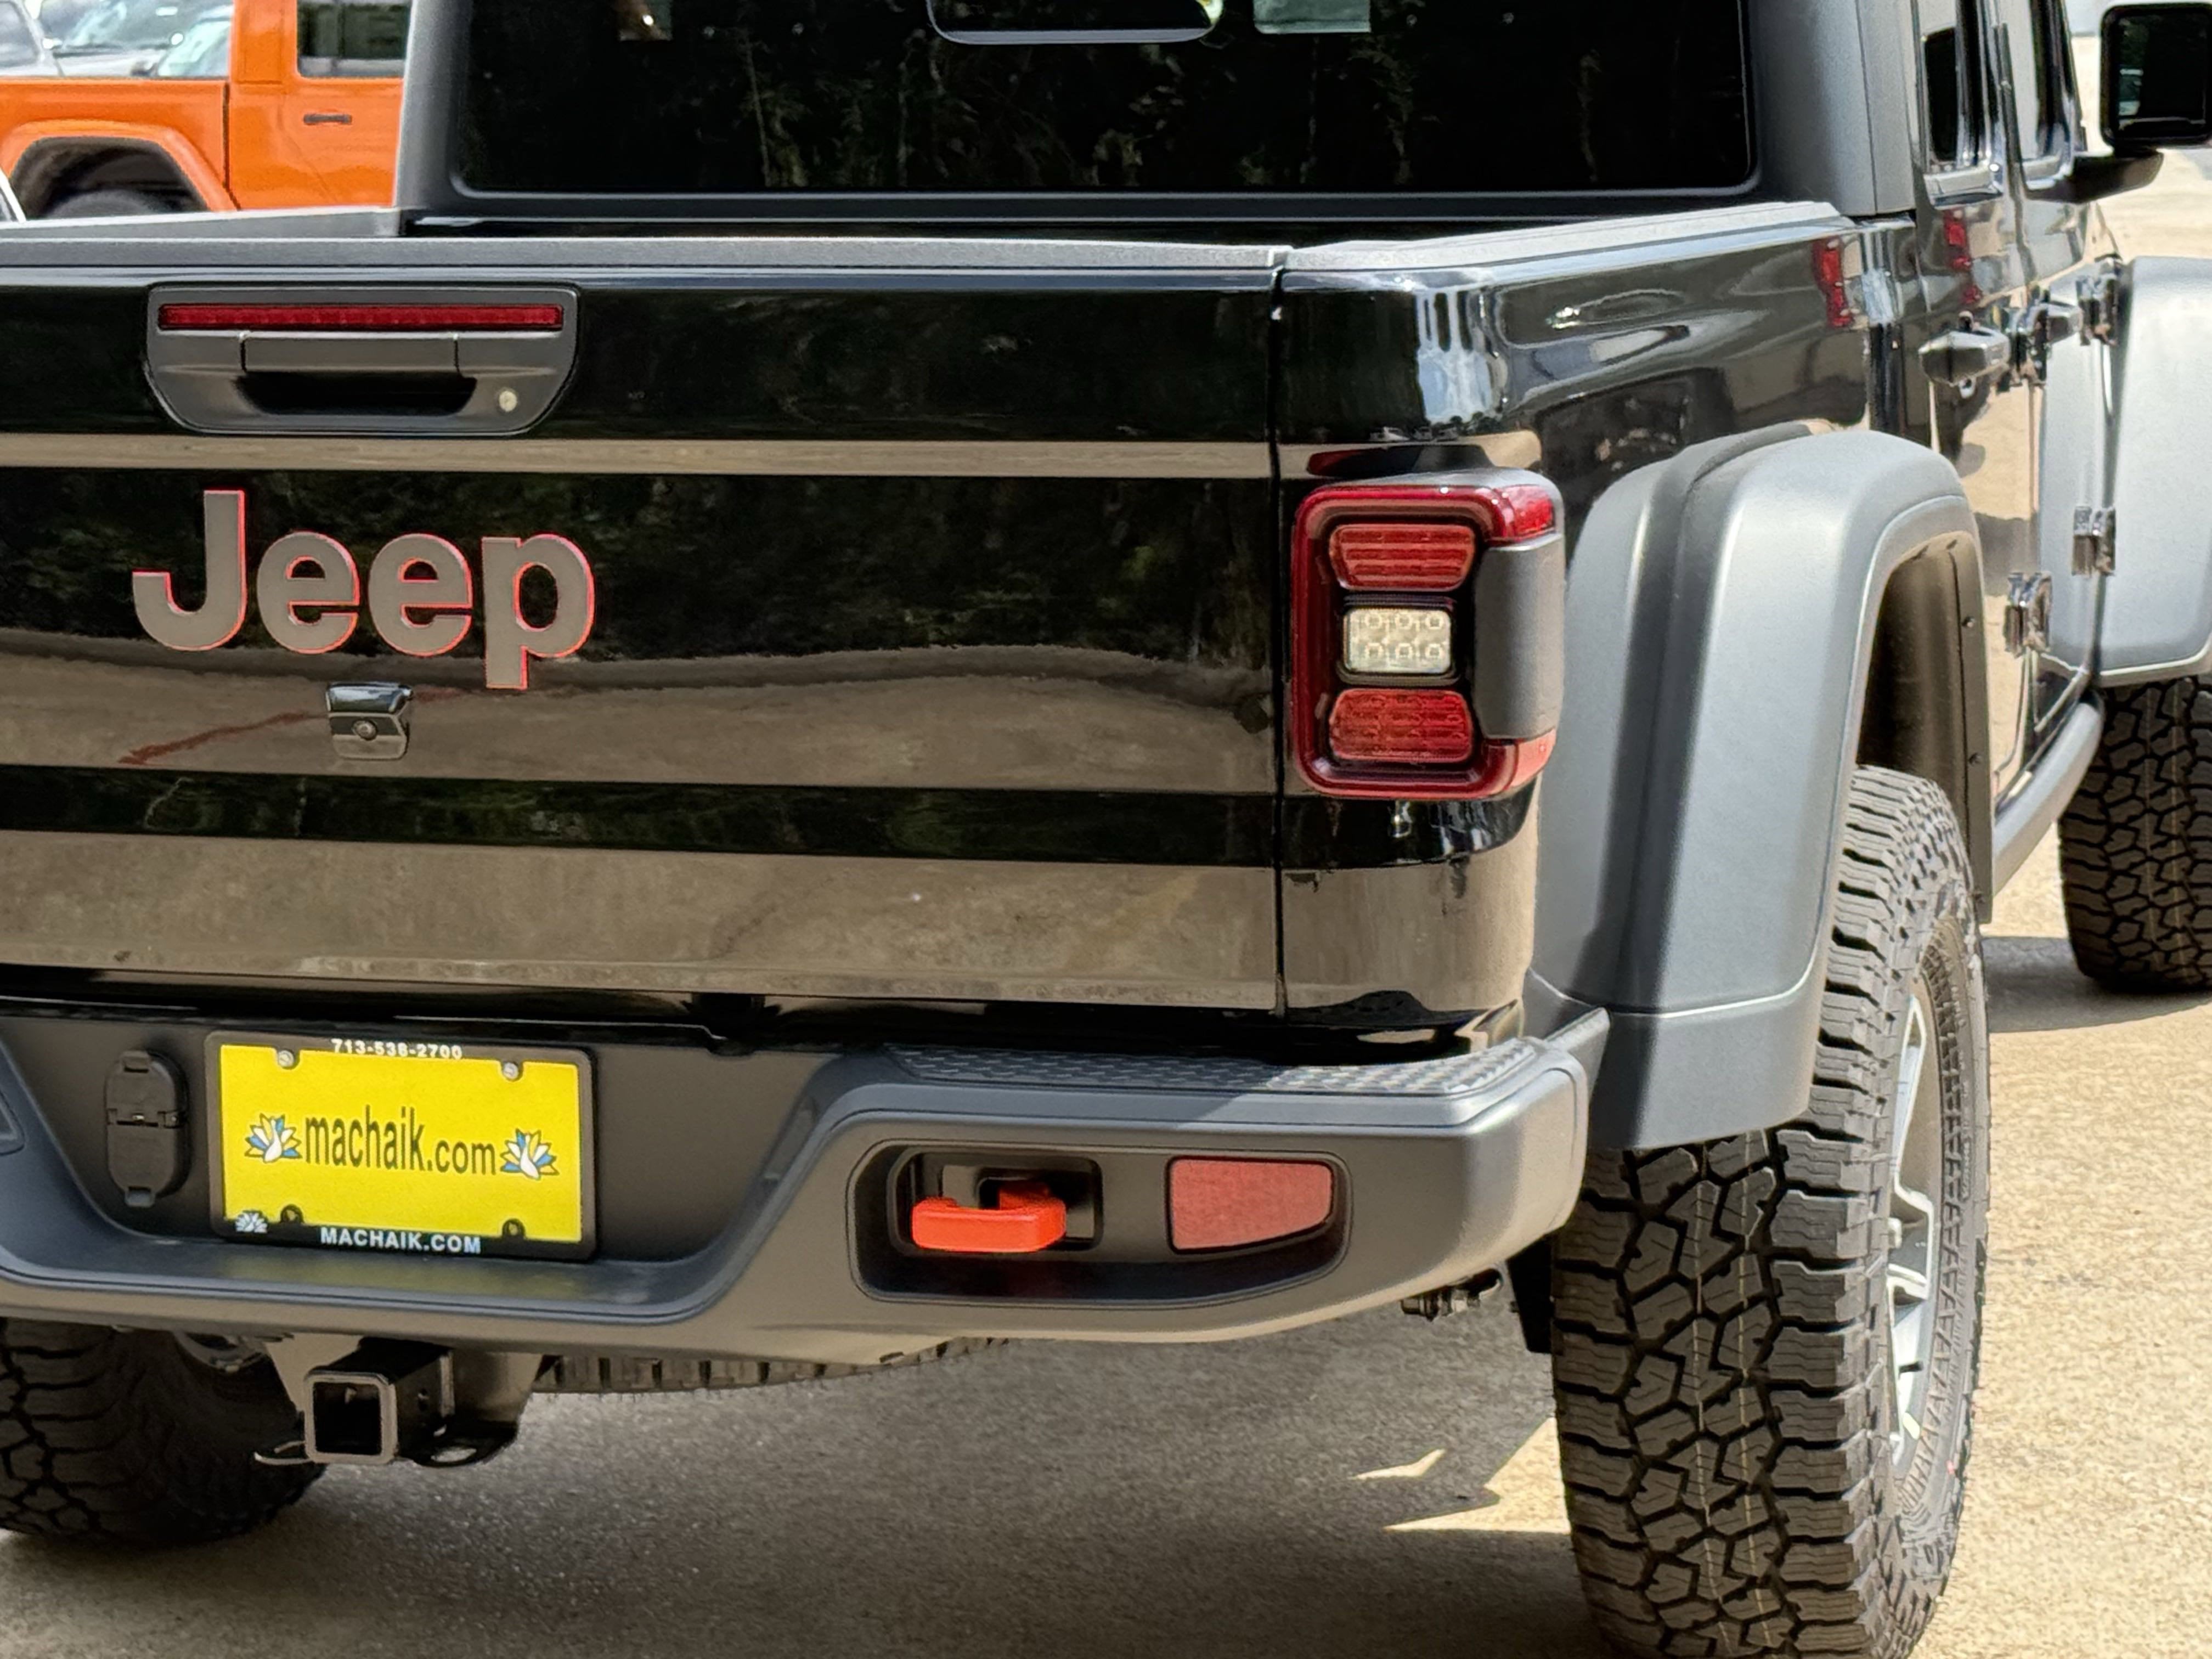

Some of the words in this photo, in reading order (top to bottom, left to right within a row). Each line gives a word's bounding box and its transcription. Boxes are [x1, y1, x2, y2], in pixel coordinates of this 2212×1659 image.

[132, 488, 596, 690] Jeep
[305, 1104, 496, 1175] machaik.com
[320, 1227, 481, 1254] MACHAIK.COM
